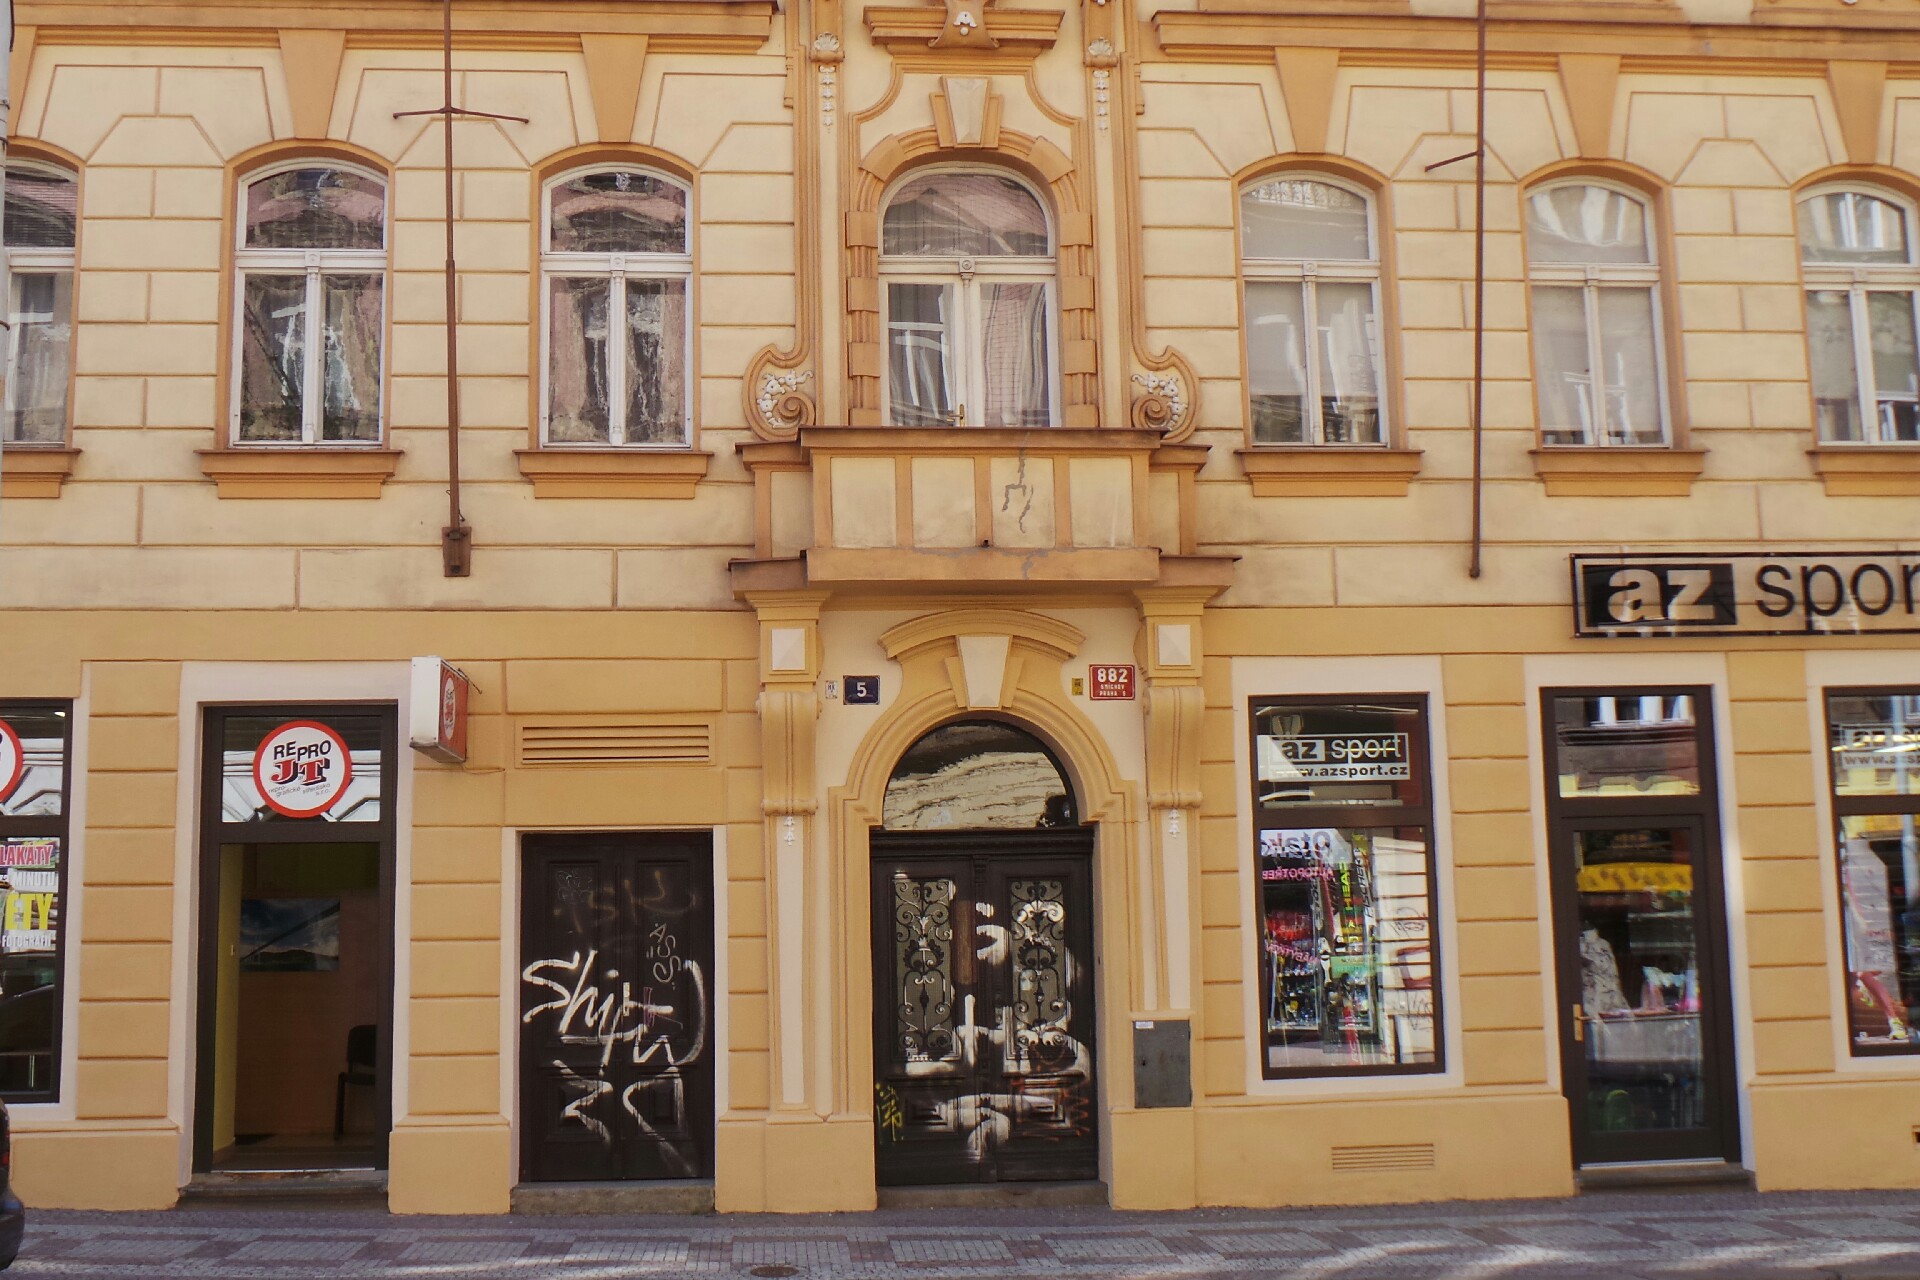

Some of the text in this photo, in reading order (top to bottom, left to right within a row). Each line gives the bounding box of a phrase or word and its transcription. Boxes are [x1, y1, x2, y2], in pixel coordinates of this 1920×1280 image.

[1607, 569, 1716, 623] az
[1097, 668, 1128, 683] 882
[856, 681, 867, 698] 5
[273, 739, 332, 761] REPRO
[1281, 734, 1401, 764] az sport
[1285, 764, 1408, 778] w.azsport.cz
